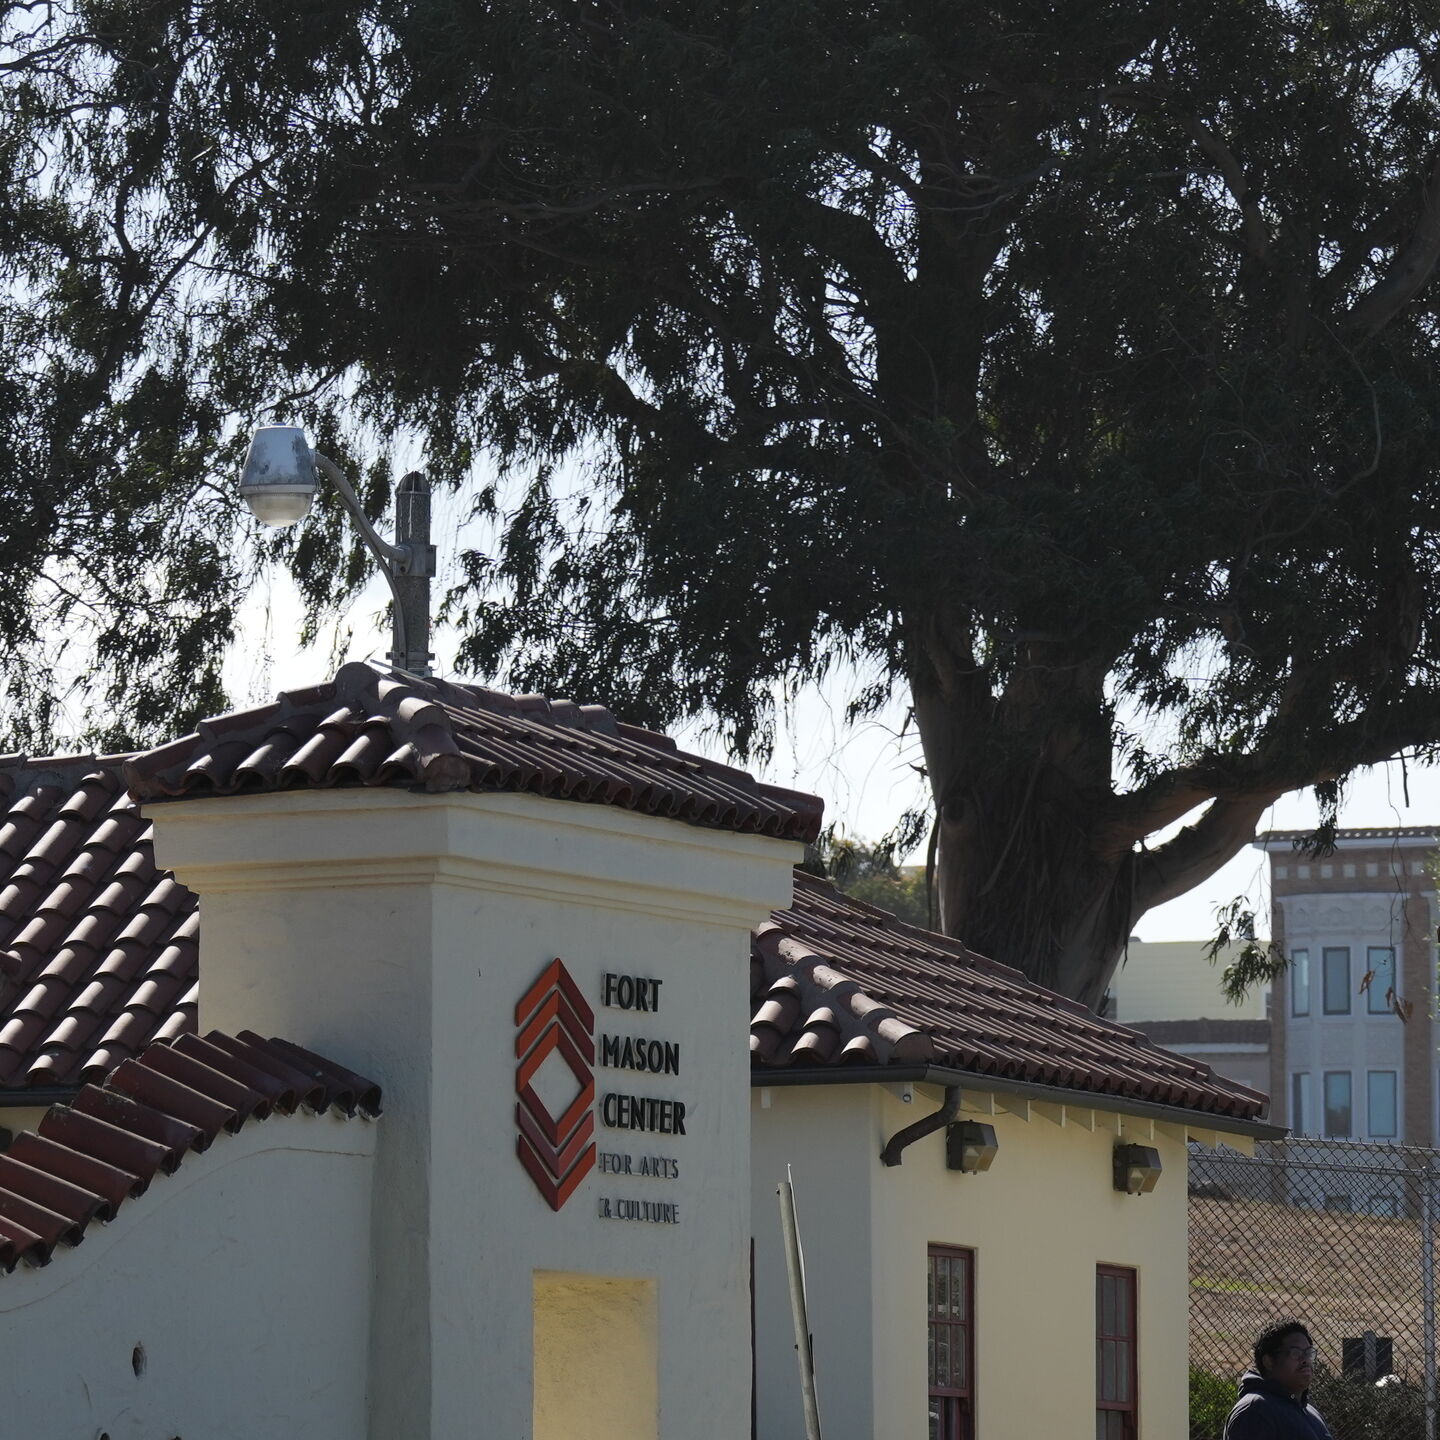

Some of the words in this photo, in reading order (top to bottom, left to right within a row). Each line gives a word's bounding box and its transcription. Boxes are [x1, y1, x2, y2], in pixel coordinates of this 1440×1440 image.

[604, 973, 663, 1013] FORT
[602, 1034, 680, 1076] MASON
[603, 1093, 686, 1136] CENTER
[601, 1152, 632, 1175] FOR
[641, 1154, 679, 1179] ARTS
[602, 1200, 612, 1218] &
[617, 1200, 680, 1224] CULTURE
